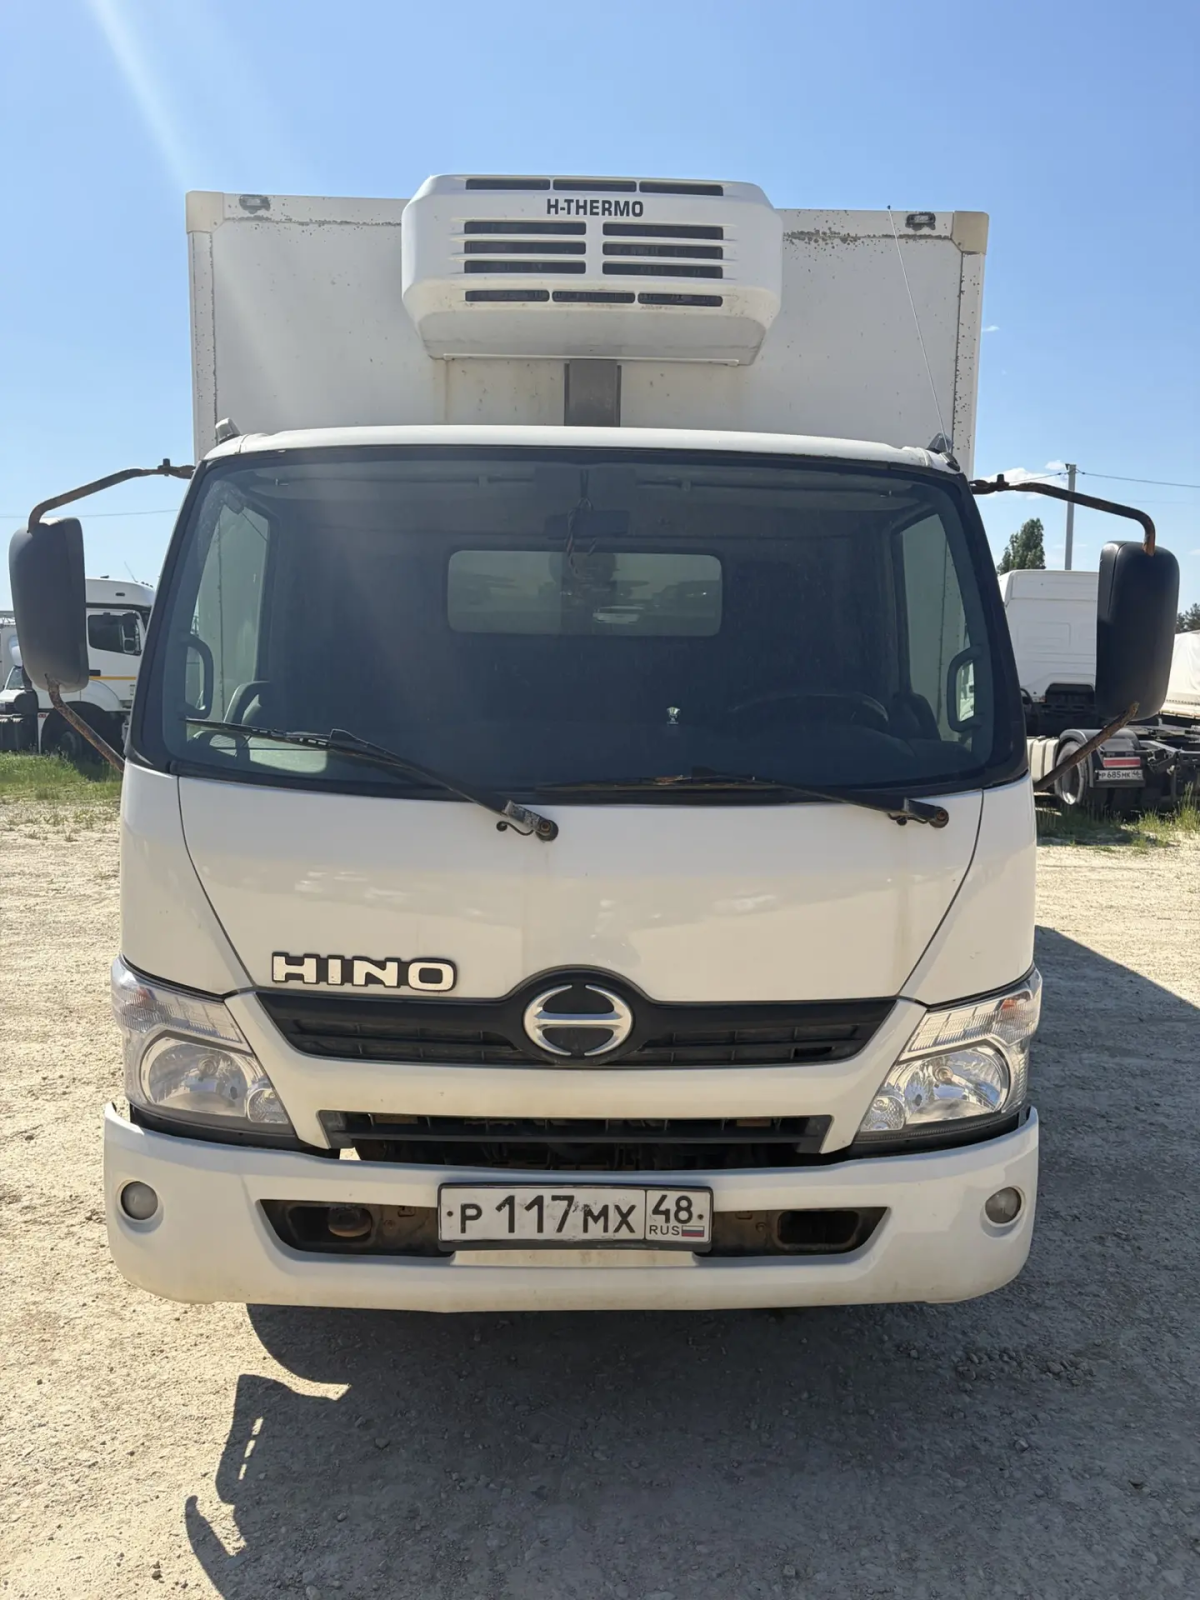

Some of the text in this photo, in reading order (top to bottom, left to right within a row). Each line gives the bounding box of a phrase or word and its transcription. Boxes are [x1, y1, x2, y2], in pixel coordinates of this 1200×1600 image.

[546, 198, 644, 217] H-THERMO
[272, 952, 457, 992] HINO
[652, 1195, 693, 1225] 48
[649, 1225, 680, 1236] RUS
